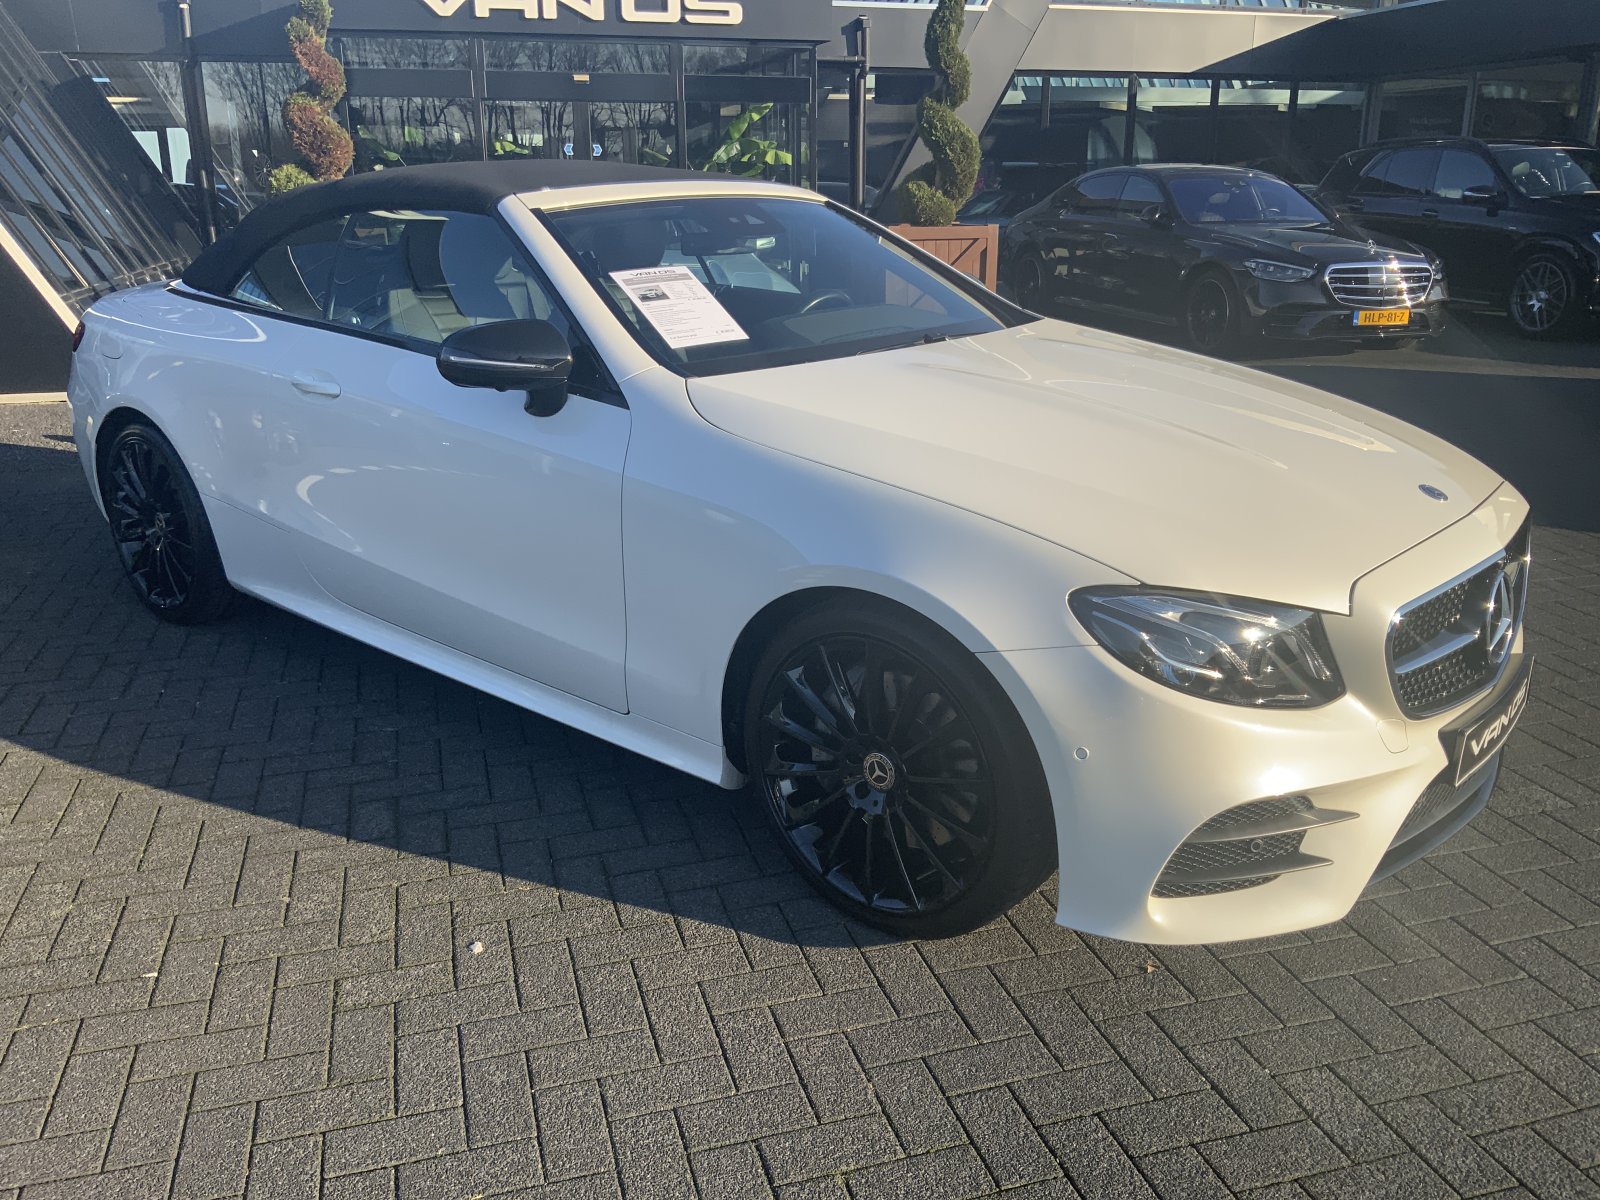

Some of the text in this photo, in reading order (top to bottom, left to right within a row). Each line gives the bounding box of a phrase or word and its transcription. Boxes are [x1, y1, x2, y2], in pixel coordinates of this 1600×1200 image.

[621, 0, 743, 25] OS
[1364, 312, 1405, 323] HLP-81-Z
[1471, 705, 1512, 756] VAN
